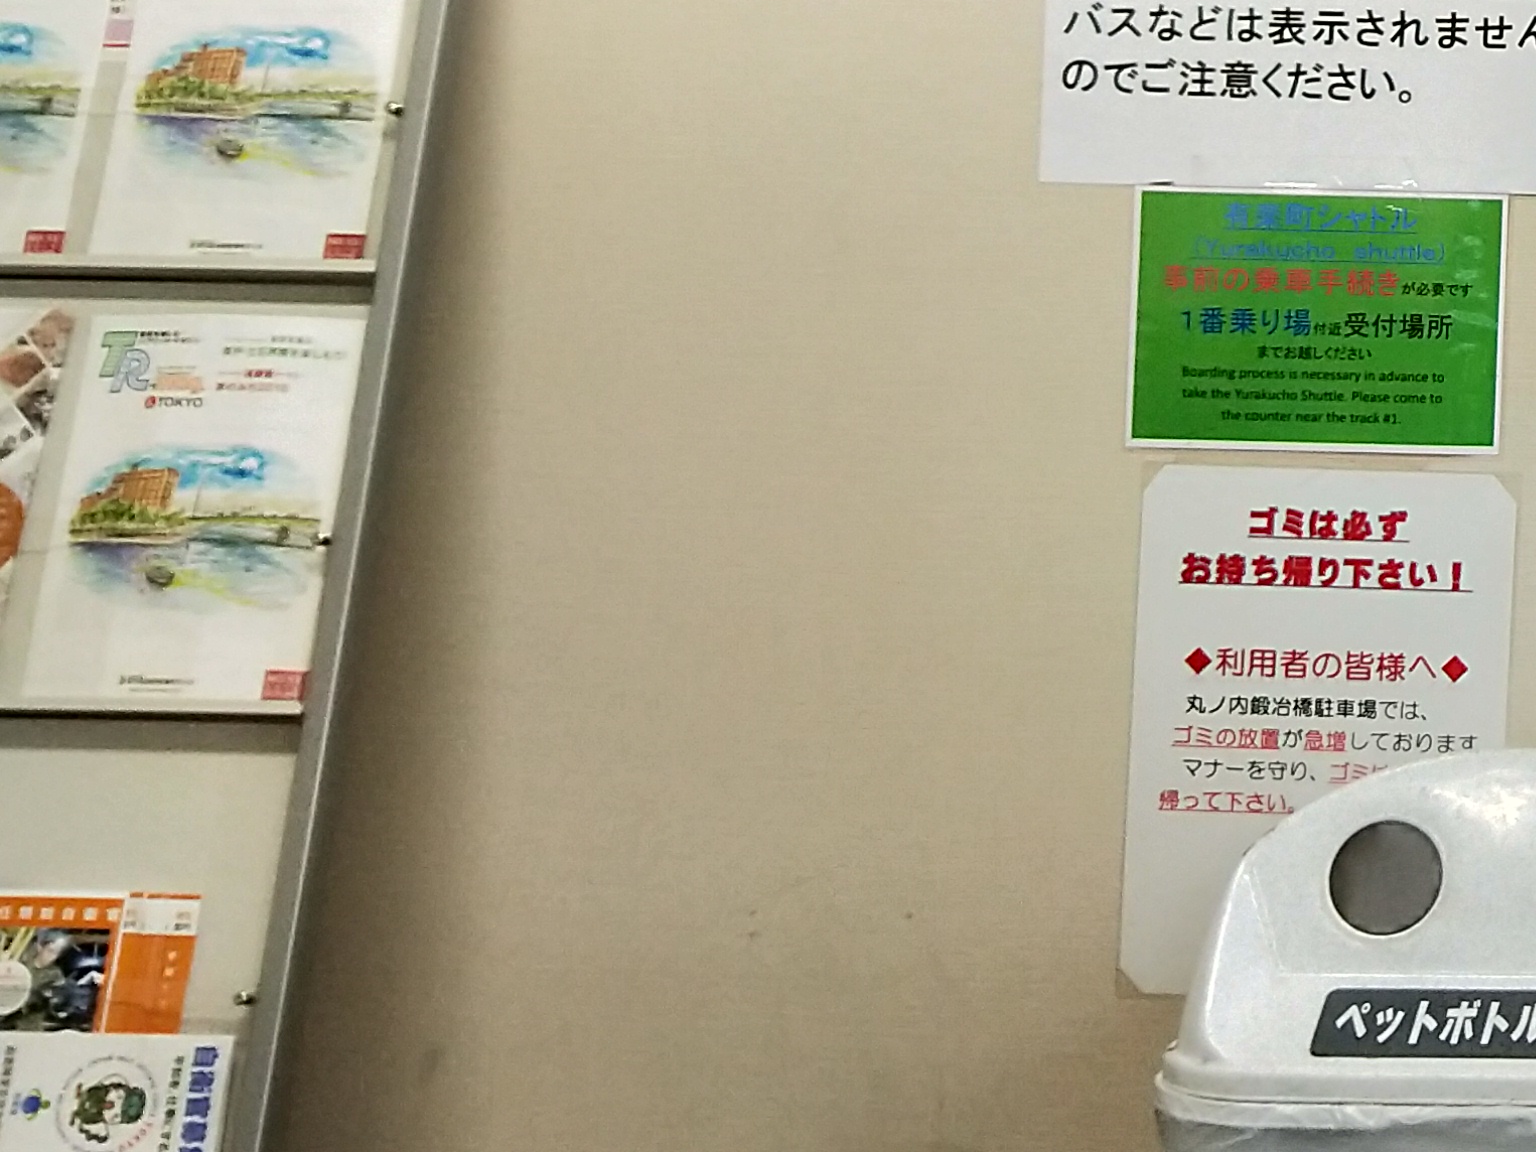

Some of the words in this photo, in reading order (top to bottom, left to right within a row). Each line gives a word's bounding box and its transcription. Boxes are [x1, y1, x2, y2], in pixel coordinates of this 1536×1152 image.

[1063, 58, 1411, 104] のでご注意ください。
[1224, 203, 1417, 231] 有楽町シャトル
[1257, 346, 1372, 361] までお越しください
[1182, 366, 1236, 380] Boarding
[1239, 369, 1285, 380] process
[1289, 369, 1297, 379] is
[1301, 371, 1361, 383] necessary
[1365, 370, 1375, 382] in
[1378, 372, 1429, 383] advance
[1432, 372, 1444, 383] to
[1248, 507, 1409, 542] ゴミは必ず
[1179, 552, 1473, 592] お持ち帰り下さい！
[1185, 695, 1428, 721] 丸ノ内鍛冶橋駐車場では、
[1172, 726, 1477, 751] ゴミの放置が急増しております
[1159, 790, 1295, 814] 帰って下さい。
